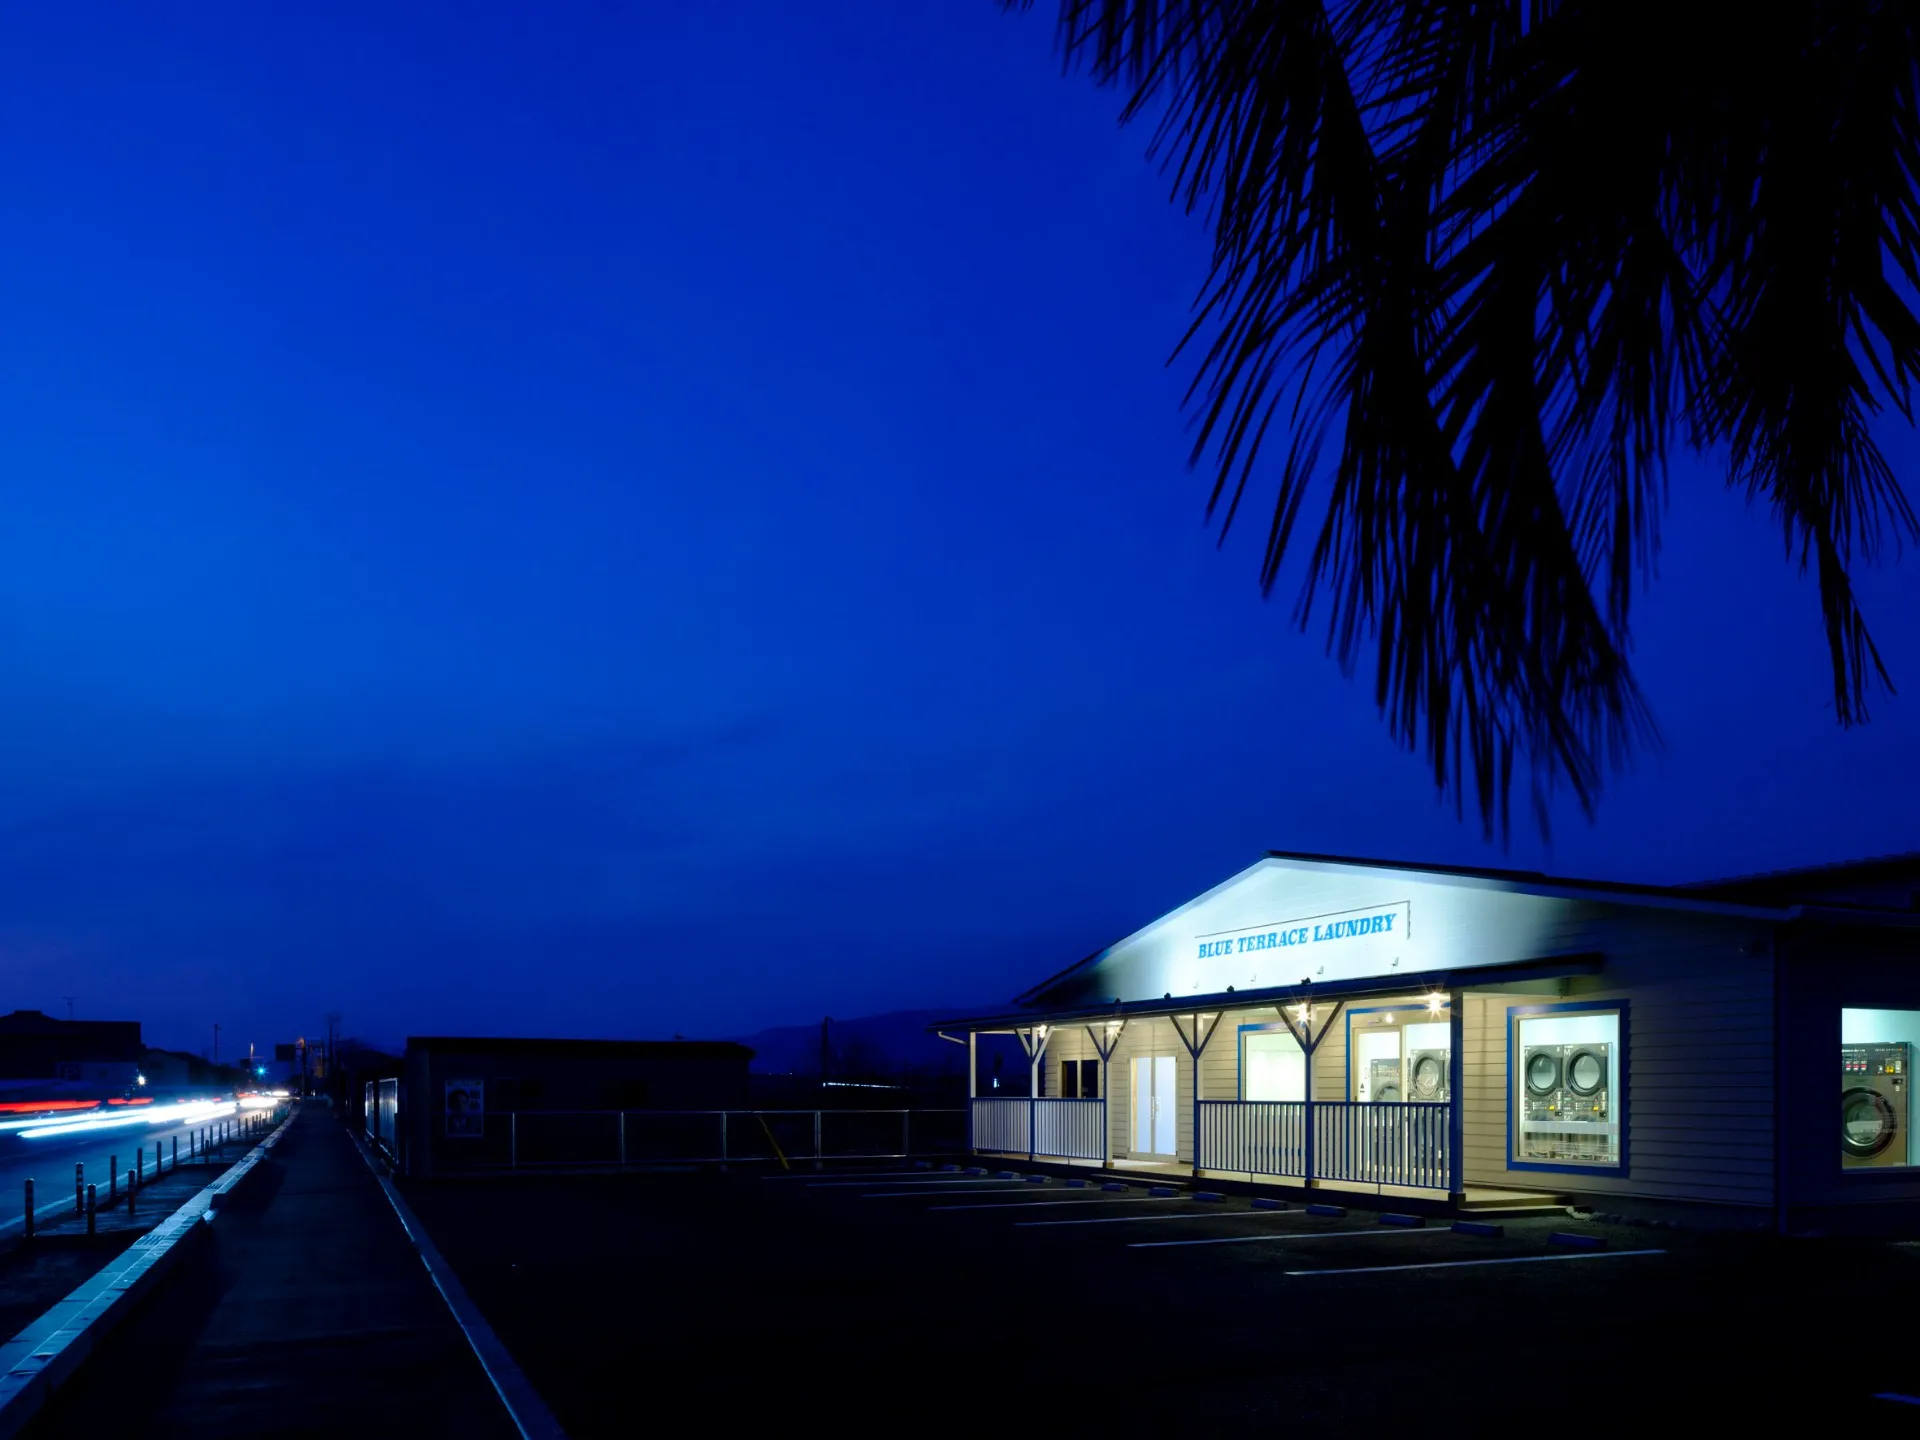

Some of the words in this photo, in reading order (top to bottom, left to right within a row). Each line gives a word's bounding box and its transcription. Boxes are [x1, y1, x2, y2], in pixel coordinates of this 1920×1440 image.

[1198, 939, 1233, 959] BLUE
[1237, 927, 1308, 953] TERRACE
[1313, 913, 1397, 942] LAUNDRY
